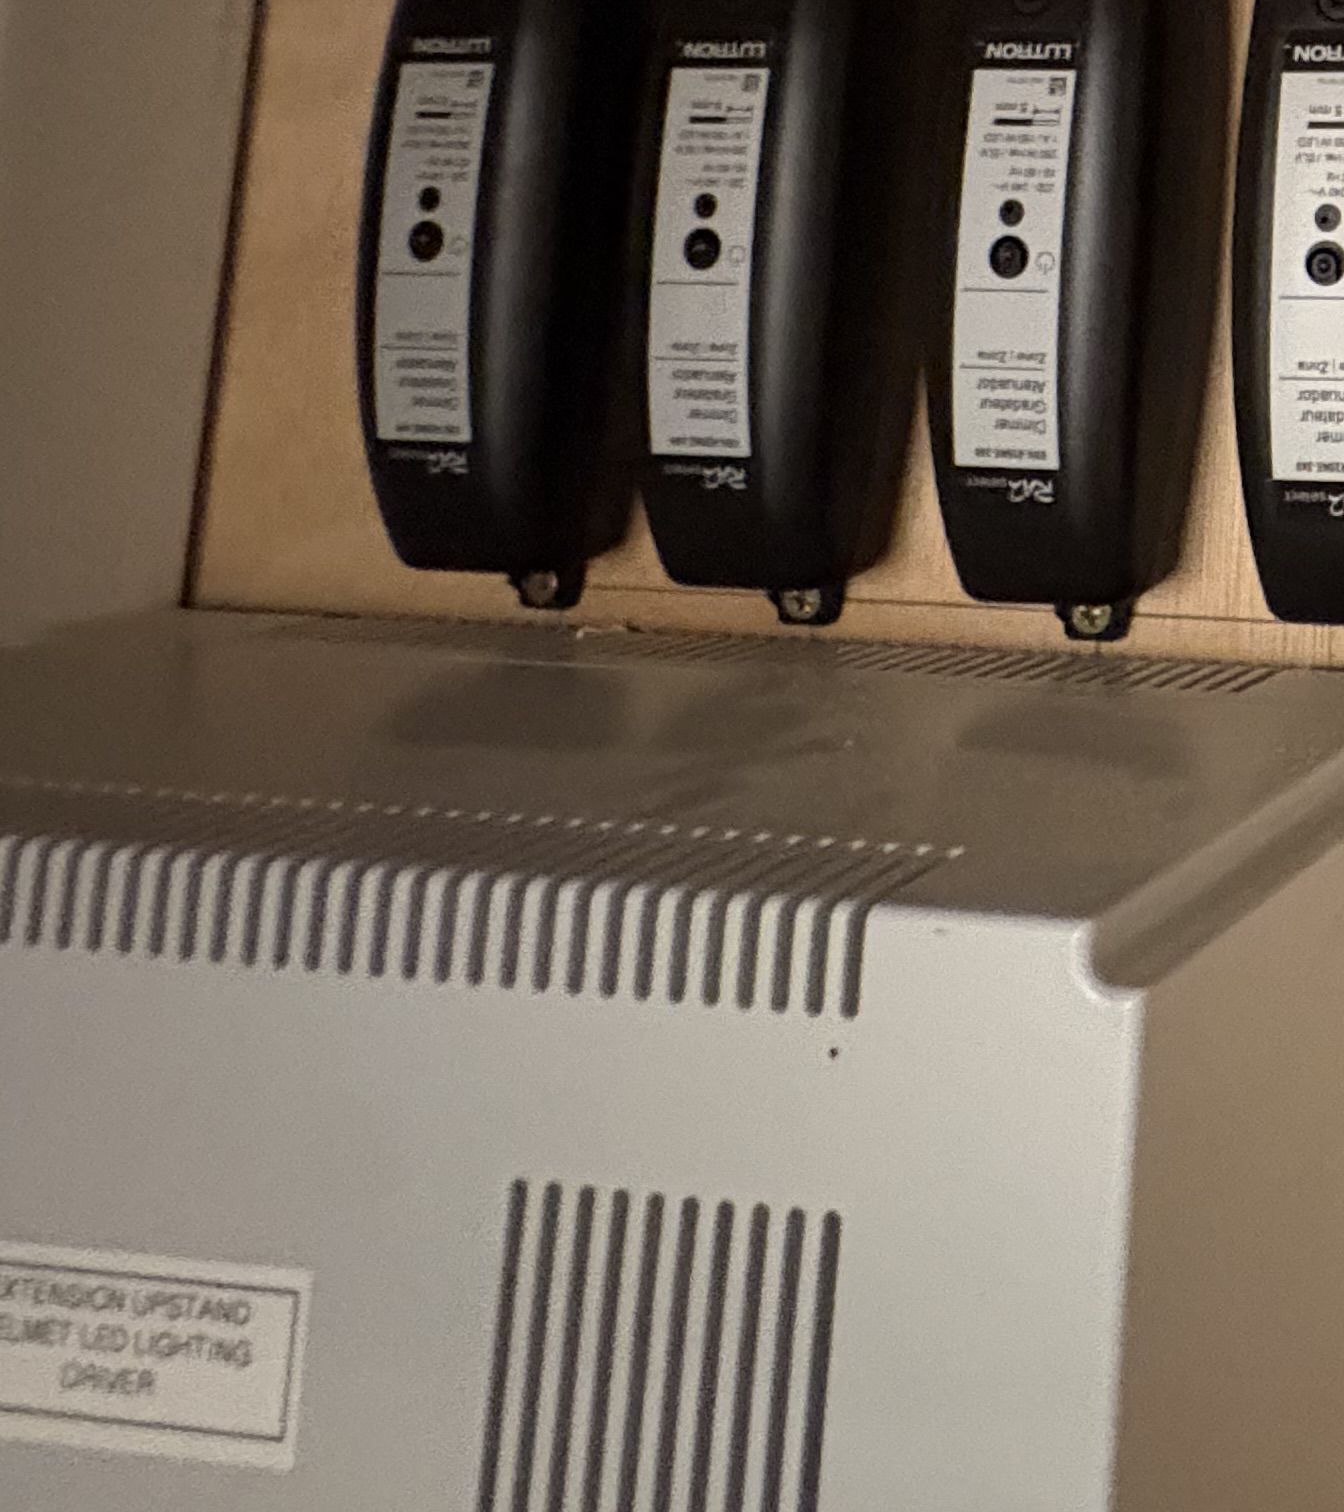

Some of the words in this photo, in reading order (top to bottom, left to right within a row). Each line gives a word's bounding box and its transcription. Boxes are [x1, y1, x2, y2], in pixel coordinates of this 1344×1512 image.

[683, 41, 766, 58] LUTRON
[984, 42, 1073, 60] LUTRON
[0, 1276, 126, 1311] XTENSION
